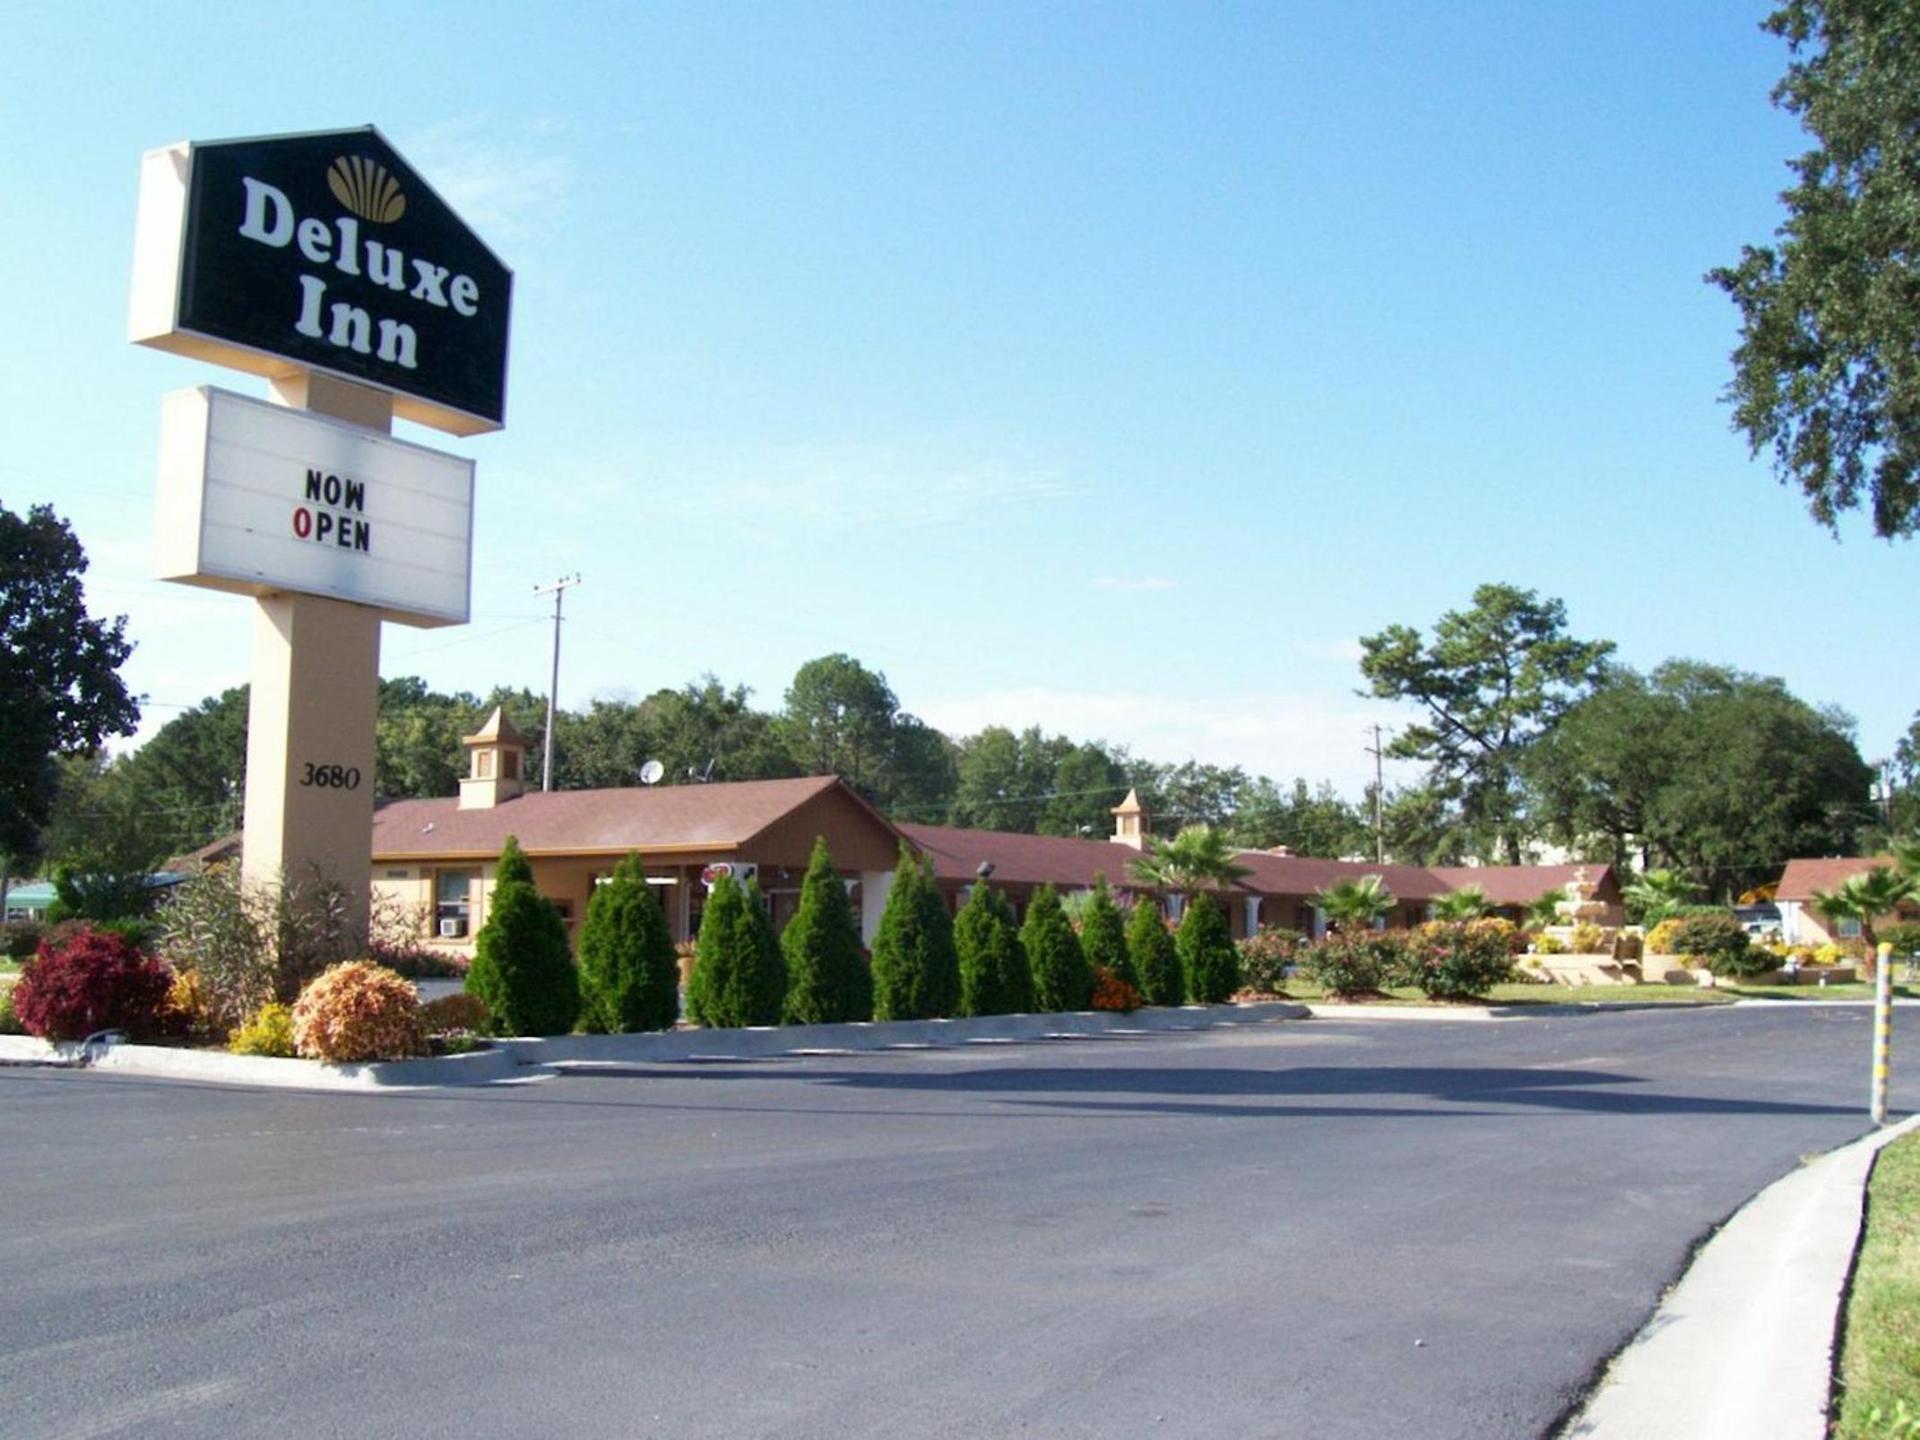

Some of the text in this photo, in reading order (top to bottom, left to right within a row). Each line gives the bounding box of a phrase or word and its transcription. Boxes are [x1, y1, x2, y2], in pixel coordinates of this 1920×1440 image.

[238, 176, 479, 317] Deluxe
[295, 274, 418, 369] Inn
[306, 469, 365, 512] NOW
[293, 507, 370, 551] OPEN
[300, 762, 361, 790] 3680
